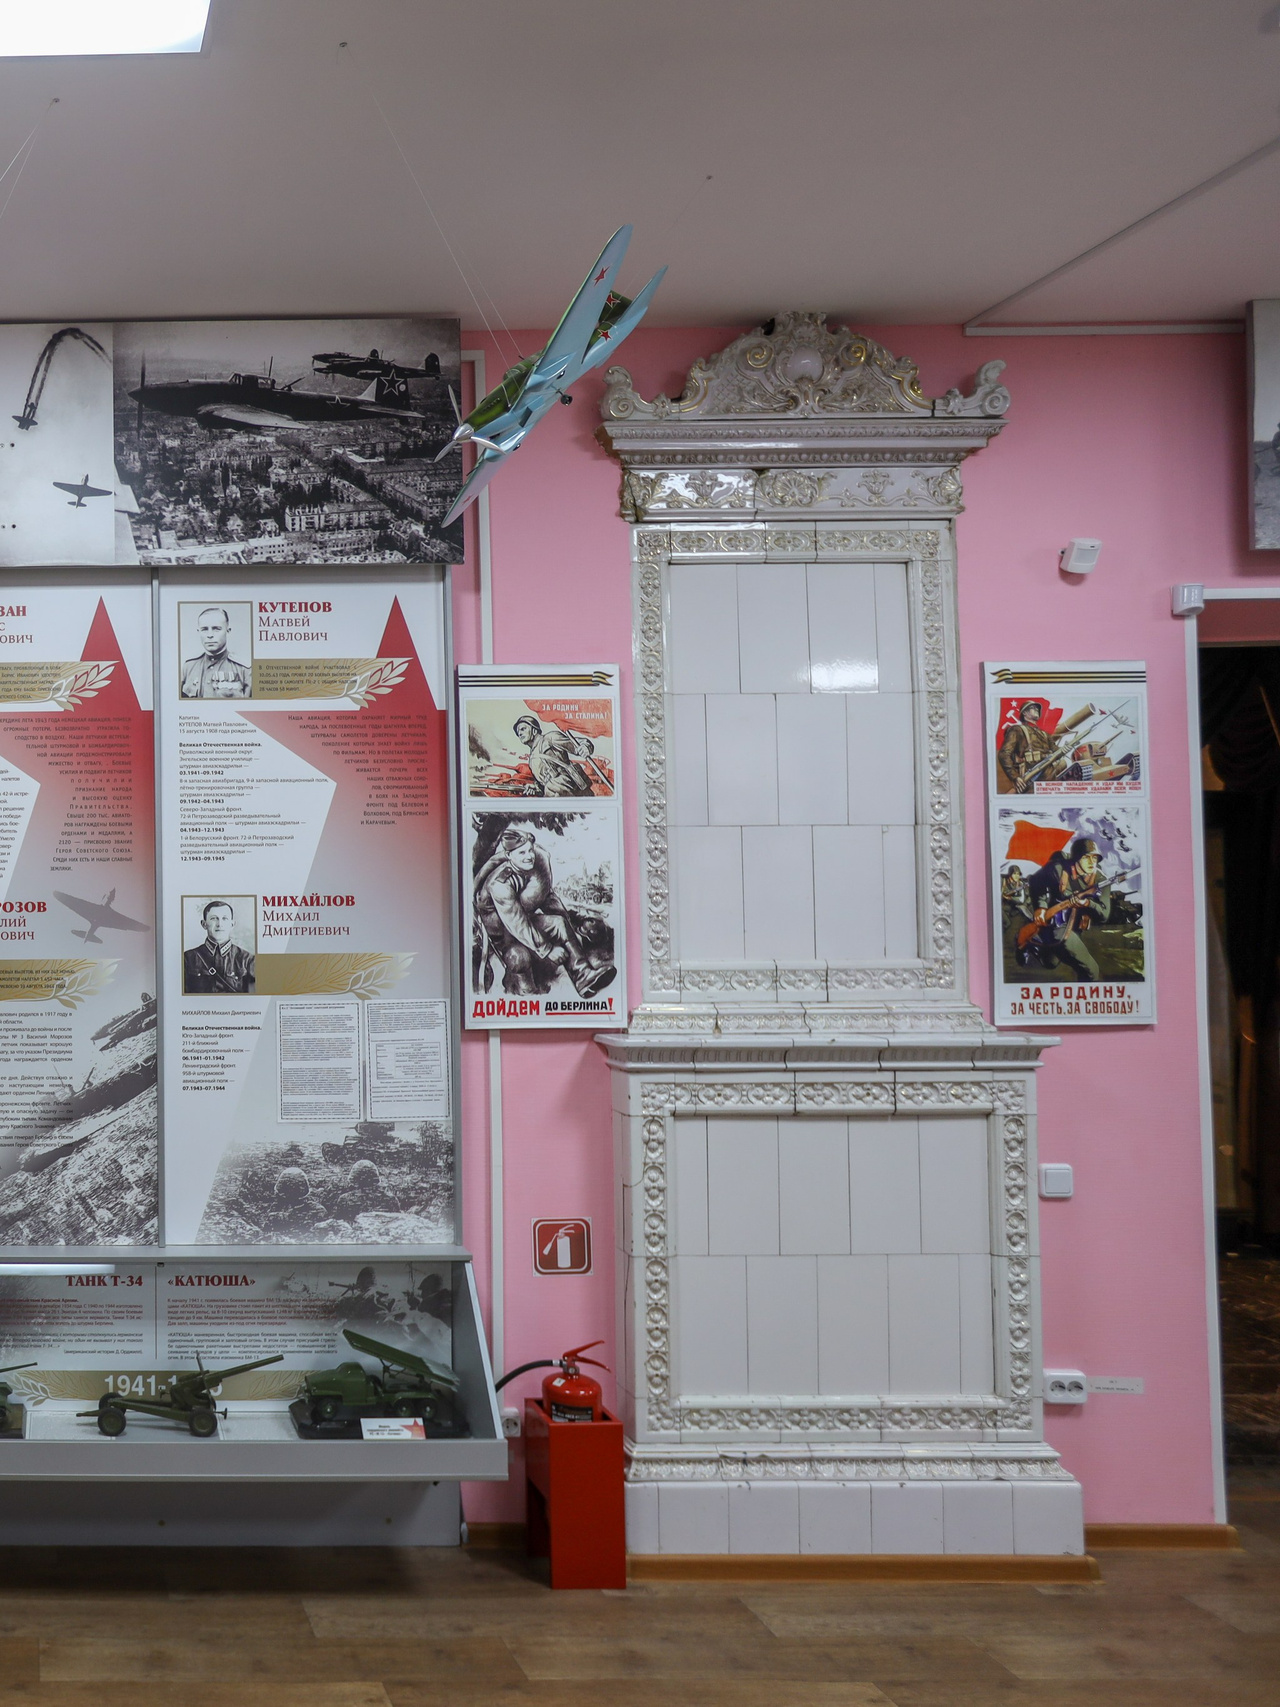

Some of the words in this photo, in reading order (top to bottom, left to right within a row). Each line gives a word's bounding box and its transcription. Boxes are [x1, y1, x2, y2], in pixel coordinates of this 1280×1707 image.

[258, 601, 332, 613] КУТЕПОВ
[553, 704, 579, 712] РОДИНУ
[262, 893, 356, 907] МИХАЙЛОВ
[1021, 987, 1043, 1000] ЗА
[1050, 986, 1131, 1001] РОДИНУ,
[472, 998, 540, 1018] ДОЙДЕМ
[544, 1002, 558, 1012] ДО
[561, 998, 614, 1011] БЕРЛИНА!
[1011, 1002, 1024, 1015] ЗА
[1085, 1000, 1139, 1014] СВОБОДУ!
[66, 1276, 108, 1288] ТАНК
[110, 1276, 144, 1288] Т-34
[168, 1274, 256, 1287] «КАТЮША»
